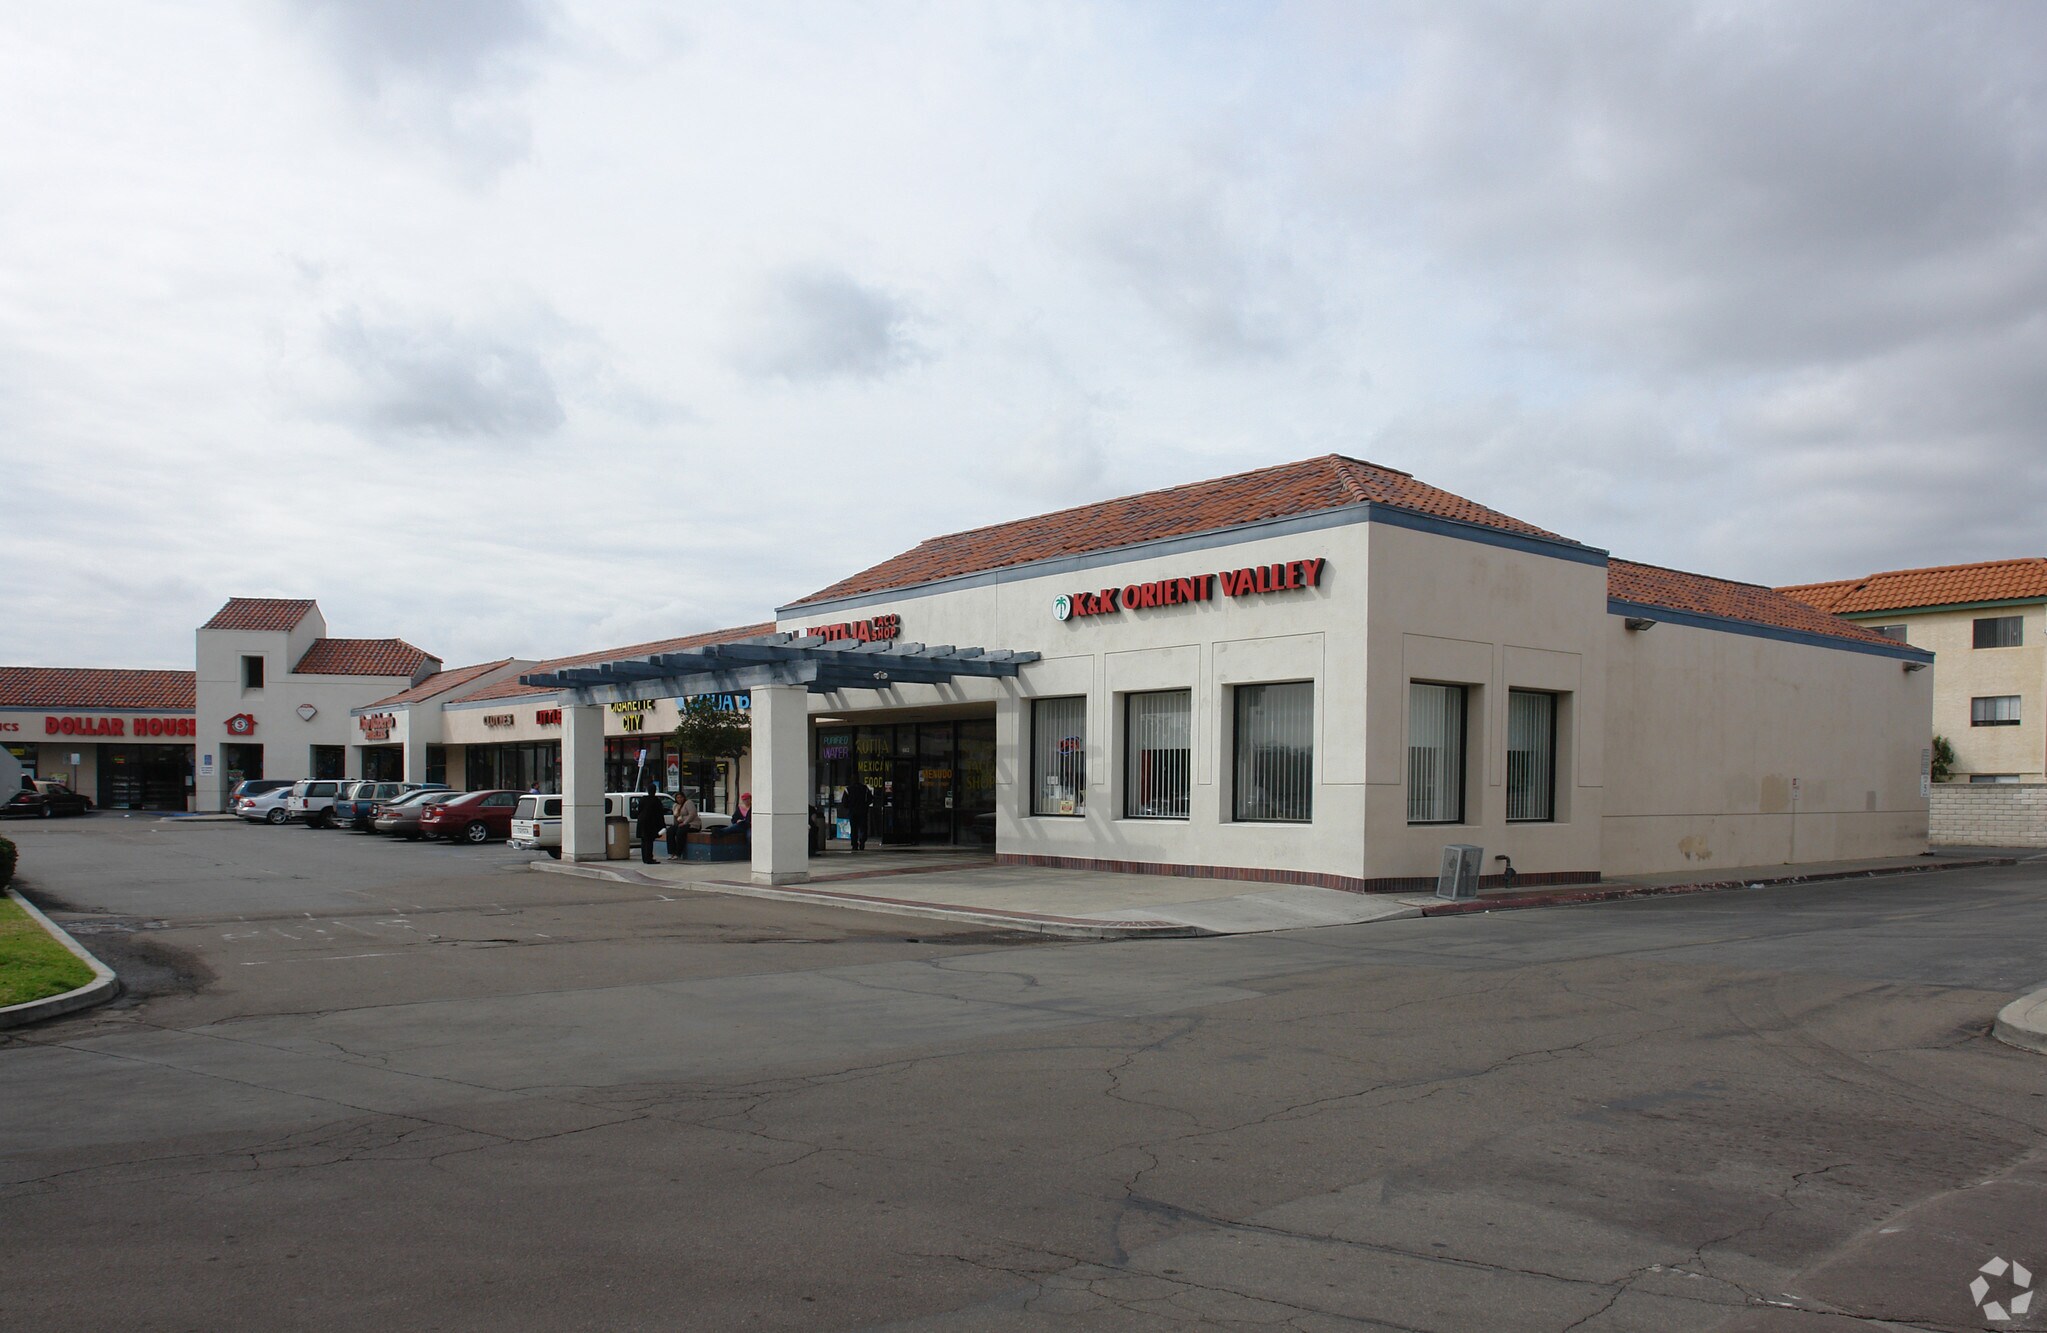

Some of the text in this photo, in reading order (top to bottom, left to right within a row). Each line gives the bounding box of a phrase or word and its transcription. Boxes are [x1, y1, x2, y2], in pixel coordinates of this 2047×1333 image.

[1072, 558, 1326, 617] K&K ORIENT VALLEY
[871, 613, 898, 627] TACO
[871, 627, 898, 641] SHOP
[45, 716, 125, 737] DOLLAR
[622, 714, 643, 731] CITY
[823, 747, 849, 760] WATER
[858, 760, 890, 772] MEXICAN
[922, 768, 952, 779] MENUDO
[864, 776, 883, 788] FOOD
